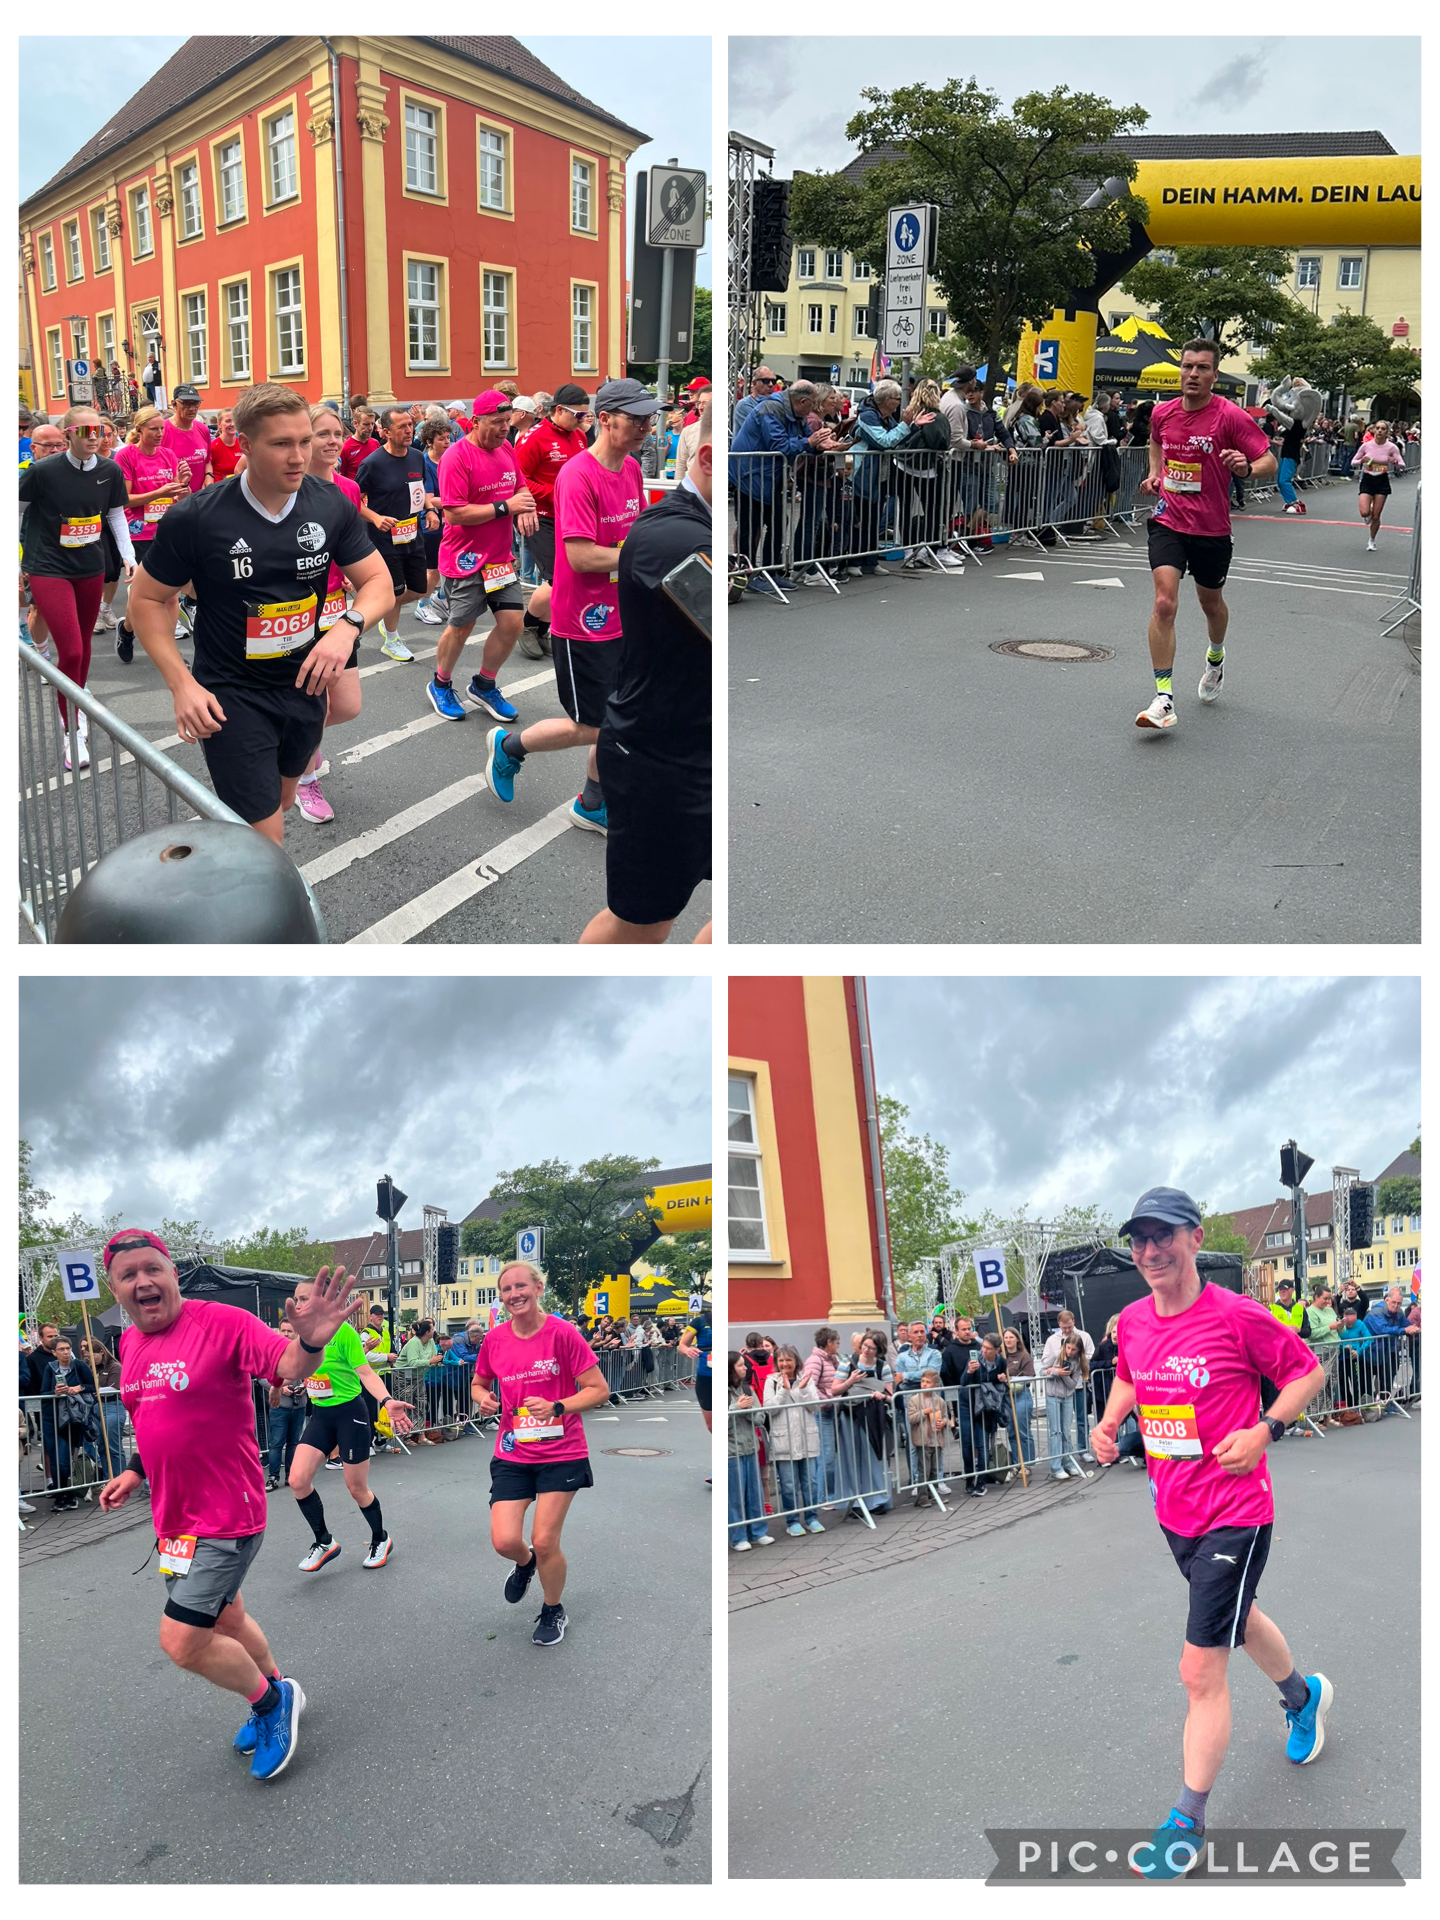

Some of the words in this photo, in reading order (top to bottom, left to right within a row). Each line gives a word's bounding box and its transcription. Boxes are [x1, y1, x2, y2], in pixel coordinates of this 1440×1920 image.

[1162, 188, 1216, 204] DEIN
[1222, 186, 1304, 204] HAMM.
[1311, 185, 1369, 203] DEIN
[1377, 185, 1422, 202] LAU
[664, 228, 690, 241] ZONE
[897, 254, 916, 265] ZONE
[890, 273, 921, 282] Lieferverkehr
[899, 283, 911, 292] frei
[896, 296, 908, 305] 7-12
[909, 296, 913, 304] h
[896, 338, 909, 348] frei
[1095, 374, 1112, 382] DEIN
[1168, 468, 1193, 481] 2012
[600, 515, 616, 523] reha
[69, 524, 97, 535] 2359
[229, 547, 253, 555] adidas
[297, 551, 330, 571] ERGO
[231, 556, 254, 580] 16
[486, 564, 511, 579] 2004
[322, 598, 343, 614] 006
[260, 611, 310, 637] 2069
[667, 1197, 700, 1210] DEIN
[66, 1263, 94, 1293] B
[980, 1260, 1004, 1288] B
[690, 1299, 700, 1309] A
[150, 1363, 160, 1374] 20
[161, 1361, 177, 1369] Jahre
[1167, 1356, 1179, 1367] 20
[502, 1375, 516, 1383] reha
[516, 1371, 528, 1379] bad
[529, 1368, 549, 1377] hamm
[1136, 1369, 1152, 1380] bad
[1155, 1370, 1184, 1381] hamm
[125, 1379, 139, 1393] bad
[141, 1378, 165, 1390] hamm
[306, 1379, 326, 1389] 2860
[1155, 1386, 1177, 1394] bewegen
[1143, 1418, 1187, 1437] 2008
